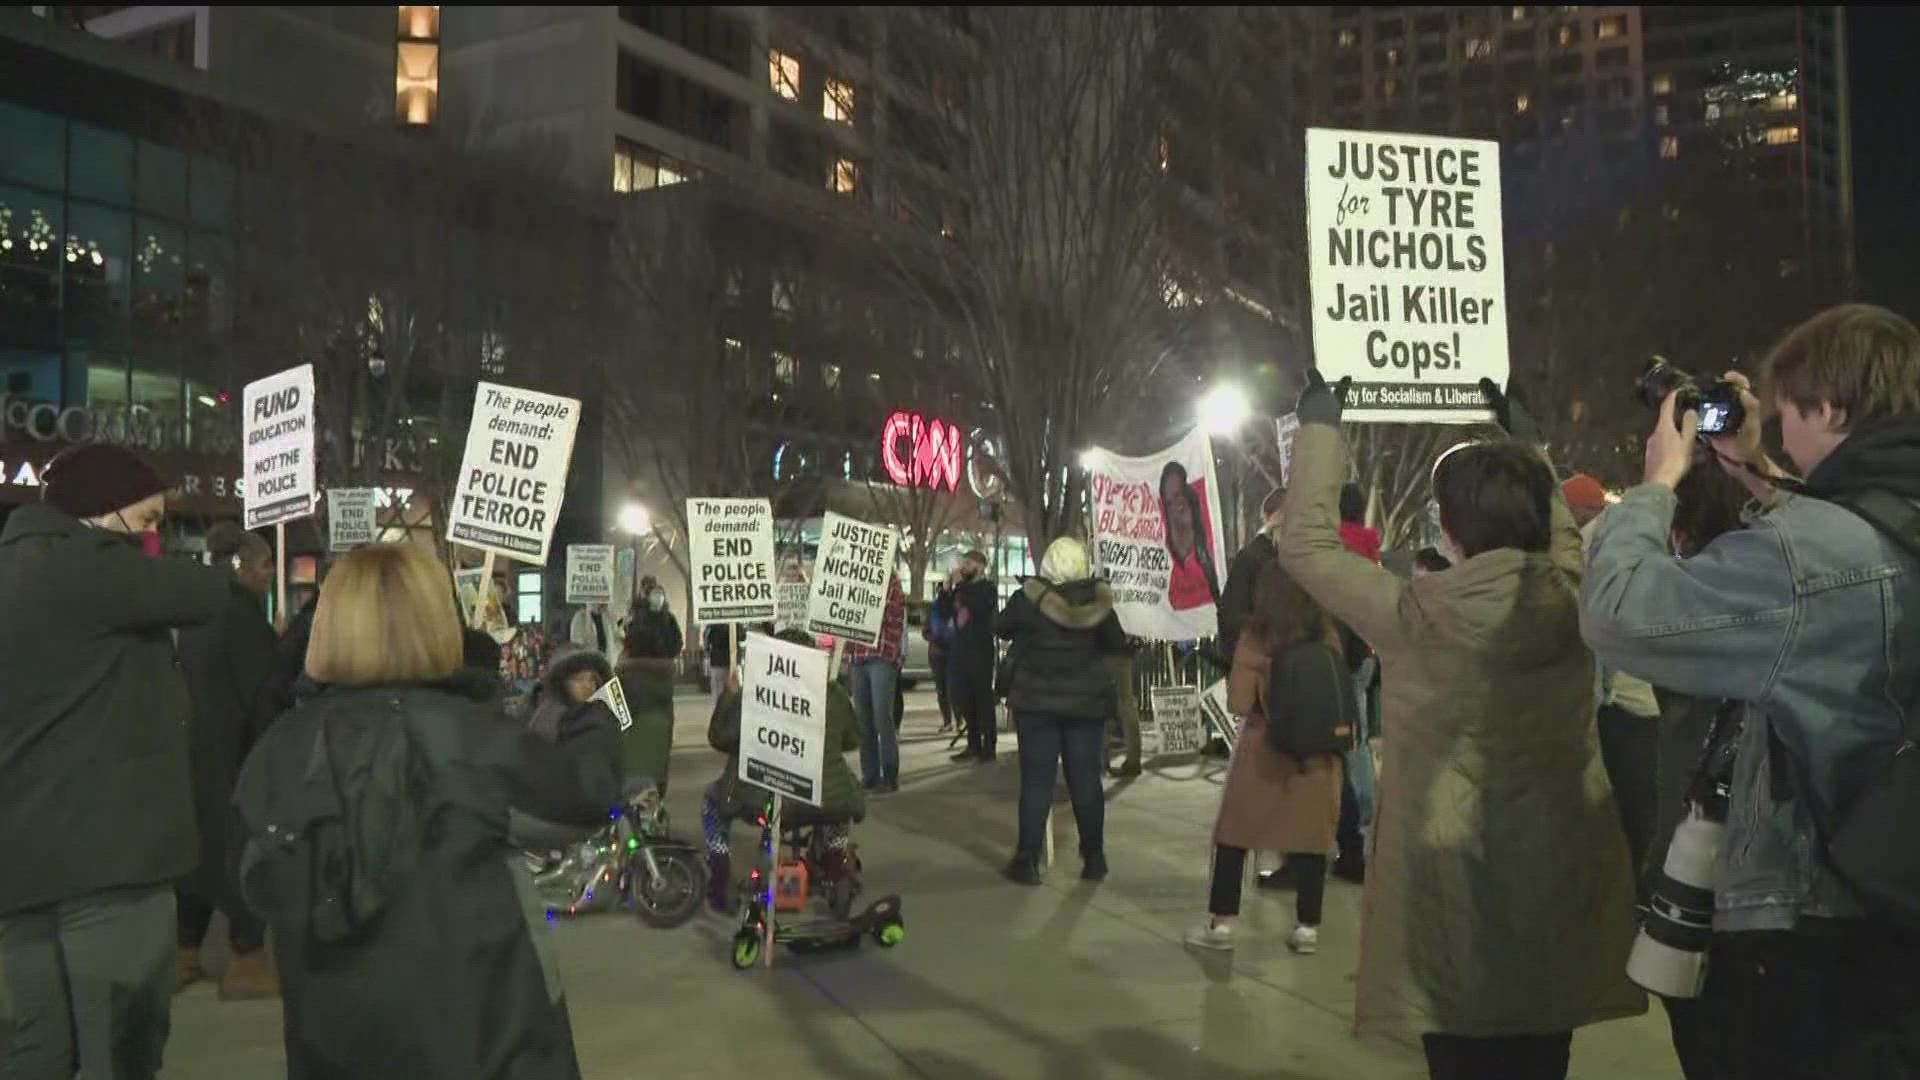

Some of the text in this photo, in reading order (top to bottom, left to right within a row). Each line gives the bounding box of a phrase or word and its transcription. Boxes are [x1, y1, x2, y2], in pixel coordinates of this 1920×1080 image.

[1328, 141, 1481, 187] JUSTICE
[1336, 183, 1475, 228] for TYRE
[1328, 228, 1487, 272] NICHOLS
[1327, 283, 1494, 325] Jail Killer
[1366, 330, 1461, 379] Cops!
[254, 386, 300, 424] FUND
[485, 388, 569, 420] The people
[1361, 387, 1377, 403] for
[1380, 387, 1432, 404] Socialism
[1434, 389, 1442, 403] &
[249, 415, 306, 446] EDUCATION
[488, 415, 554, 440] demand:
[254, 448, 300, 475] NOT THE
[489, 438, 539, 470] END
[883, 411, 961, 493] CNN
[257, 473, 297, 498] POLICE
[468, 468, 548, 504] POLICE
[462, 494, 547, 533] TERROR
[695, 502, 766, 518] The people
[704, 518, 761, 533] demand:
[831, 521, 890, 550] JUSTICE
[713, 538, 752, 557] END
[850, 544, 884, 567] TYRE
[702, 563, 767, 582] POLICE
[823, 556, 885, 586] NICHOLS
[699, 583, 772, 603] TERROR
[818, 580, 883, 609] Jail Killer
[828, 601, 867, 625] Cops!
[766, 653, 801, 678] JAIL
[755, 684, 811, 717] KILLER
[757, 727, 805, 758] COPS!
